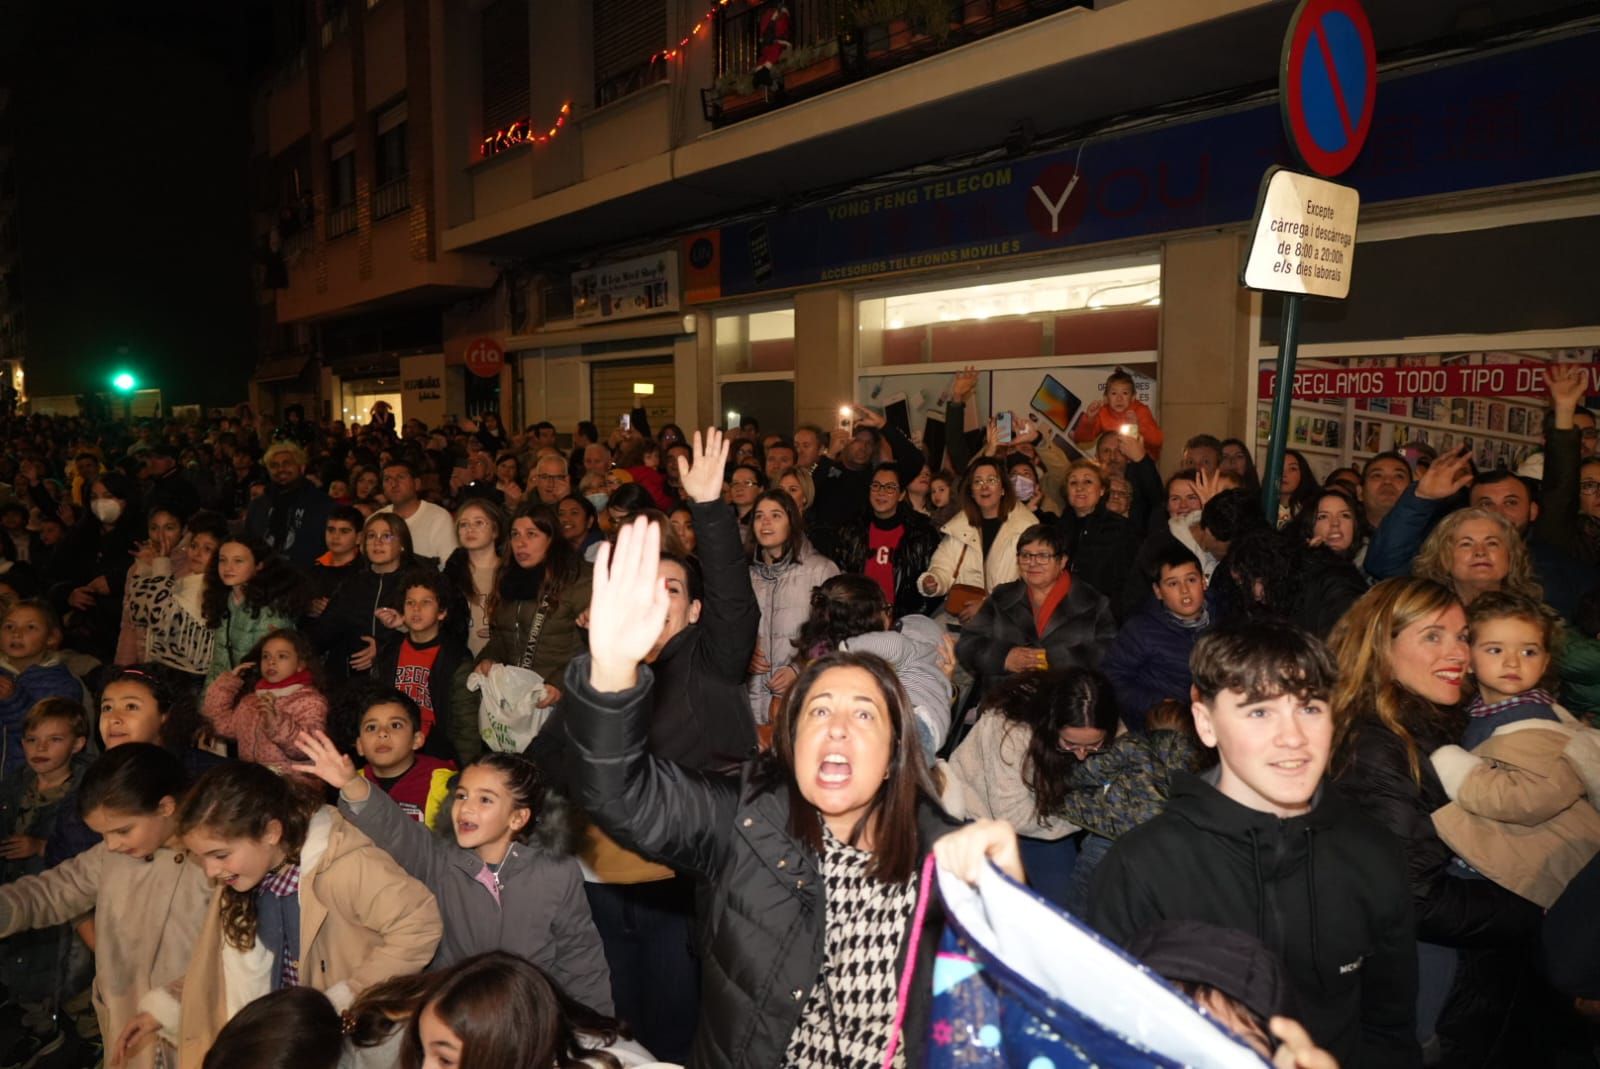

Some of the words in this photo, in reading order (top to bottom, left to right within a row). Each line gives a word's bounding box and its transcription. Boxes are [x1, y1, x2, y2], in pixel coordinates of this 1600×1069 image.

[827, 199, 870, 222] YONG
[874, 186, 918, 210] FENG
[923, 168, 1012, 201] TELECOM
[1306, 200, 1334, 220] Excepte
[1270, 218, 1309, 237] càrrega
[821, 261, 887, 281] ACCESORIOS
[889, 250, 958, 272] TELEFONOS
[961, 240, 1021, 261] MOVILES
[1277, 241, 1291, 256] de
[1294, 243, 1313, 258] 8:00
[1314, 249, 1319, 260] a
[1273, 260, 1293, 274] els
[1296, 261, 1312, 277] dies
[471, 342, 500, 363] ria
[1269, 371, 1384, 396] AREGLAMOS
[1395, 369, 1447, 394] TODO
[1459, 368, 1505, 393] TIPO
[1516, 368, 1545, 393] DE
[876, 546, 890, 565] G
